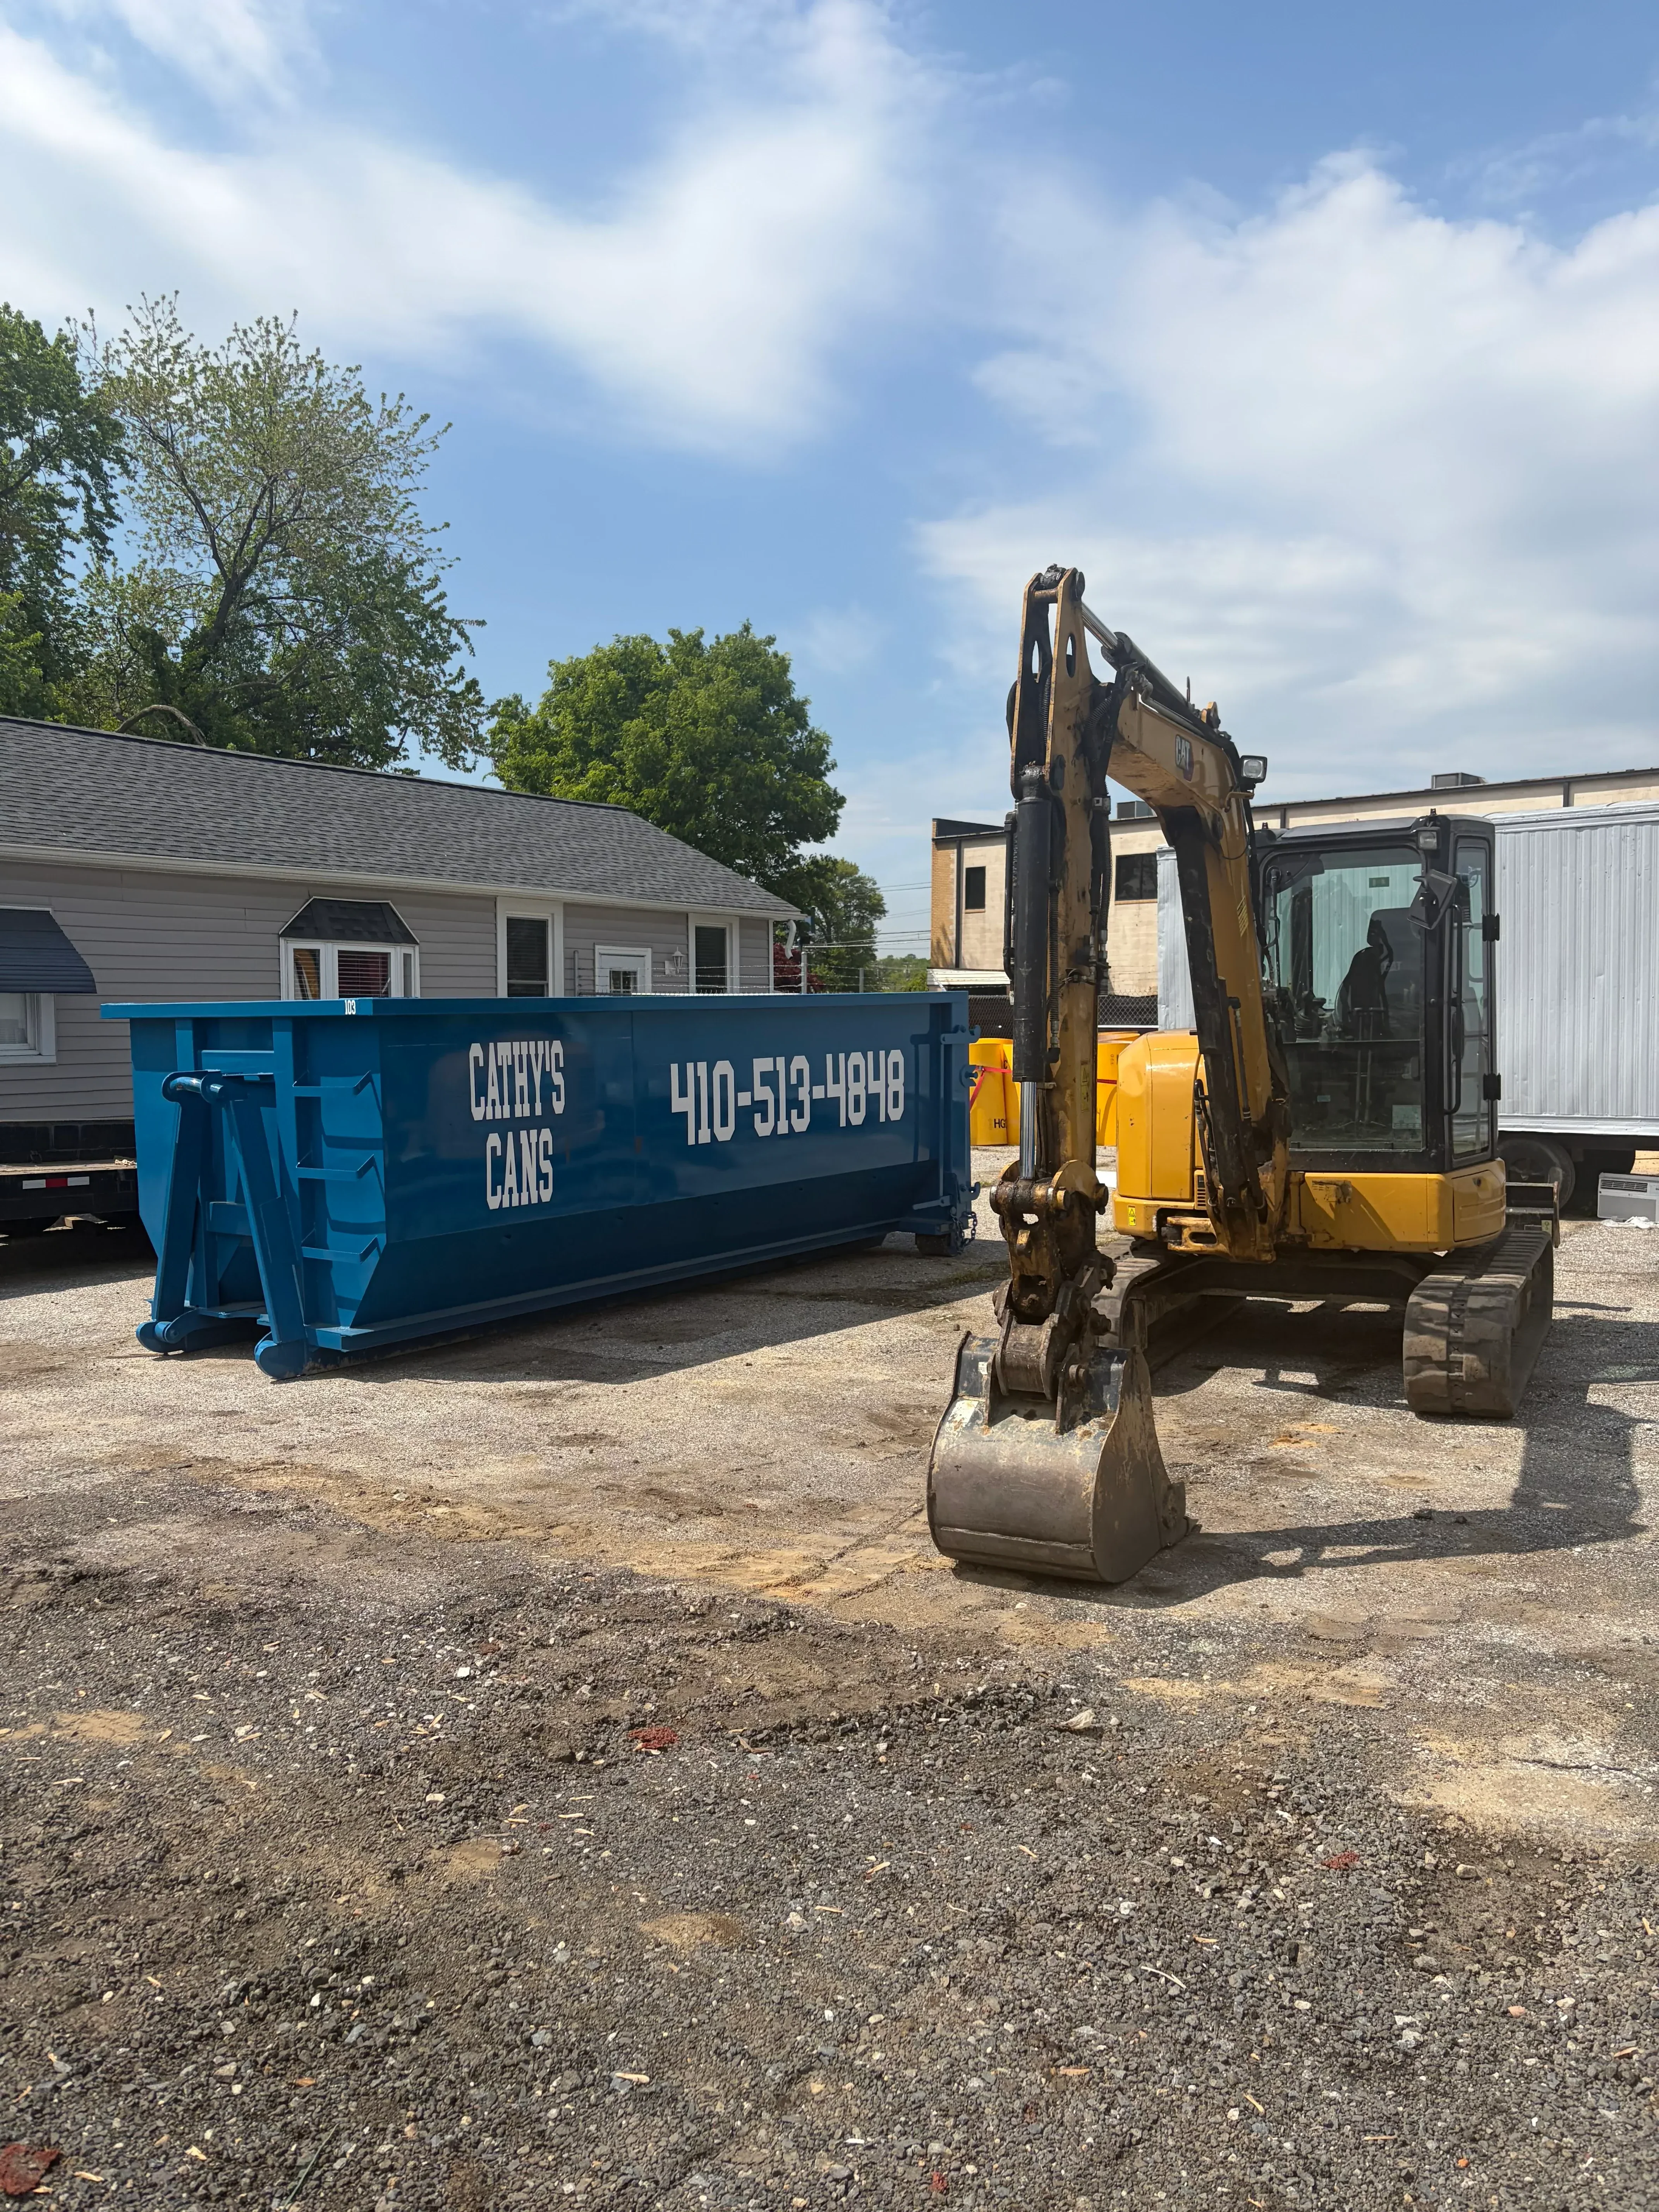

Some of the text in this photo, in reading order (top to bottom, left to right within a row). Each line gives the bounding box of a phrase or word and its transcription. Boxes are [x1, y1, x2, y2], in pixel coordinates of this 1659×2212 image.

[1176, 735, 1190, 771] CAT
[344, 1000, 356, 1015] 103
[469, 1040, 565, 1121] CATHY'S
[670, 1049, 905, 1145] 410-513-4848
[994, 1119, 1006, 1128] HG
[486, 1128, 553, 1210] CANS
